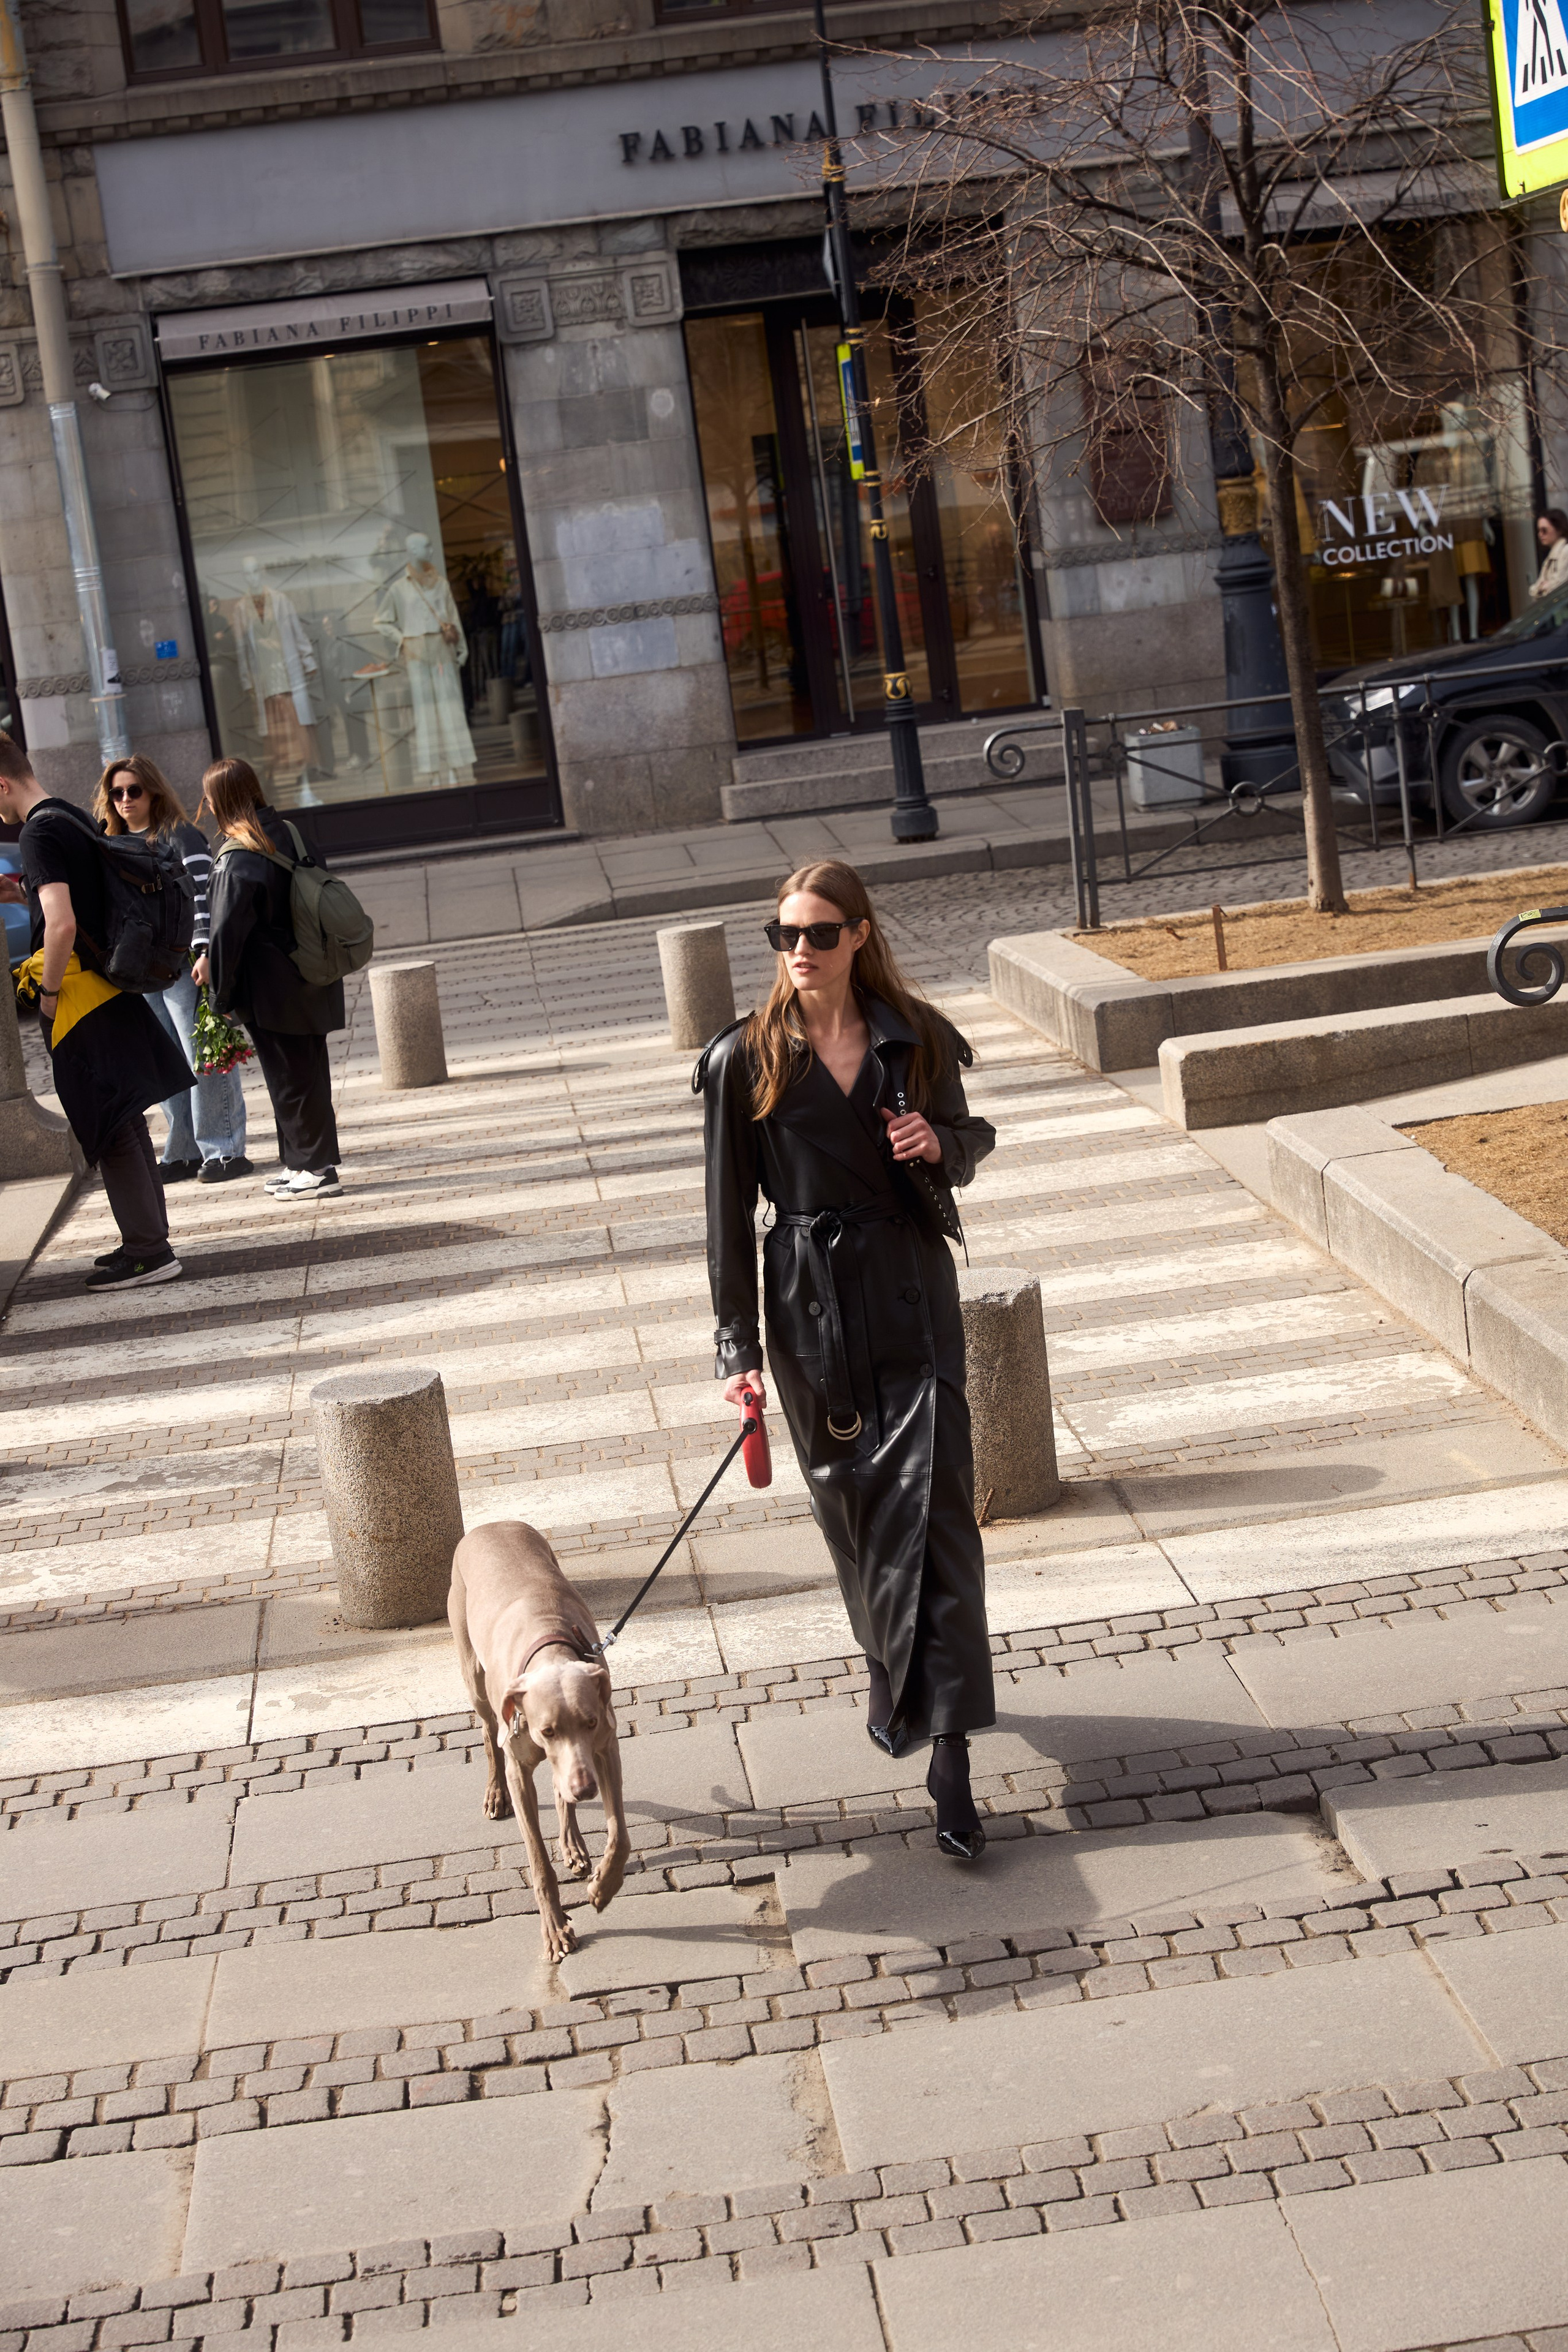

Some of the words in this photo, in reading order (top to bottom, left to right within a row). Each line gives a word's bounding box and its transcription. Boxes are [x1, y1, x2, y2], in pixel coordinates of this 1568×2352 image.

[619, 110, 827, 163] FABIANA
[199, 322, 319, 350] FABIANA
[340, 304, 452, 332] FILIPPI
[1318, 484, 1452, 541] NEW
[1323, 533, 1455, 565] COLLECTION
